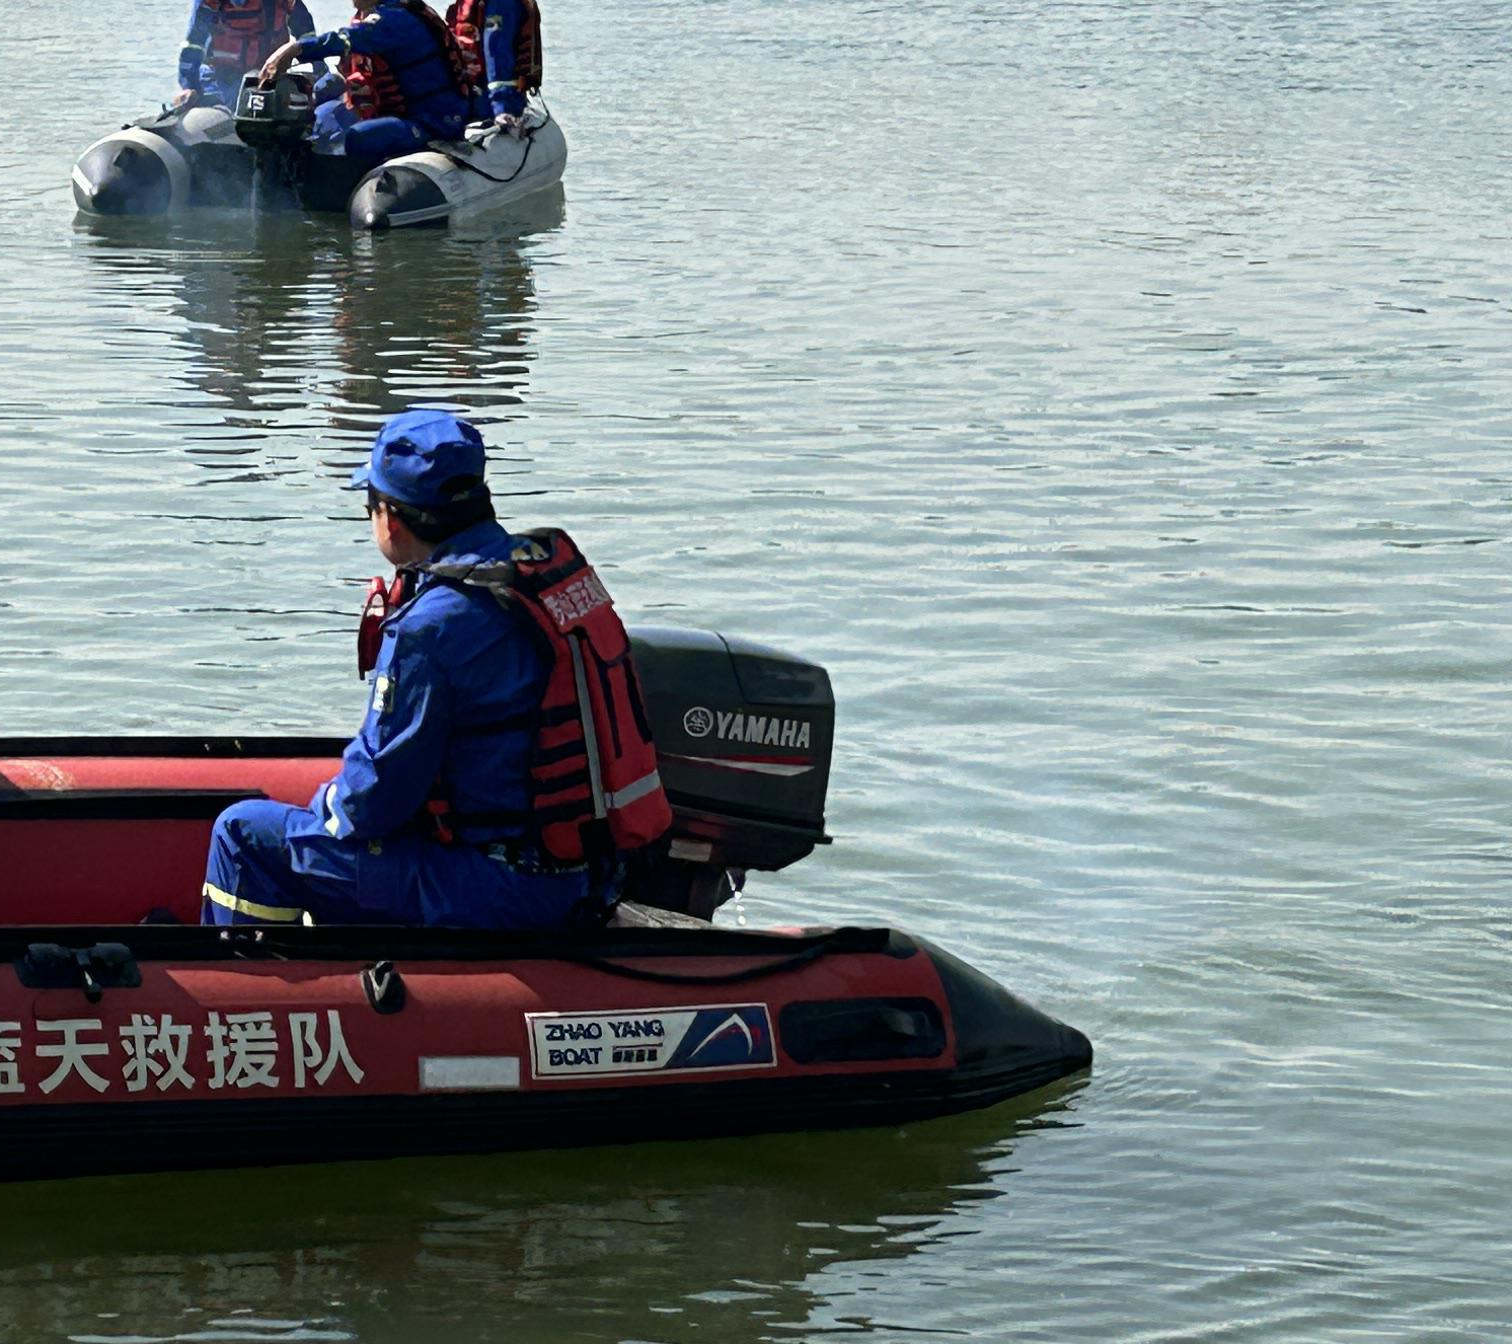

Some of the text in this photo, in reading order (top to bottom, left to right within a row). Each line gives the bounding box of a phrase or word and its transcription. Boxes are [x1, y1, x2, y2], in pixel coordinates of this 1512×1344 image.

[716, 711, 810, 748] YAMAHA
[545, 1019, 665, 1041] ZHAO YANG
[548, 1047, 603, 1066] BOAT
